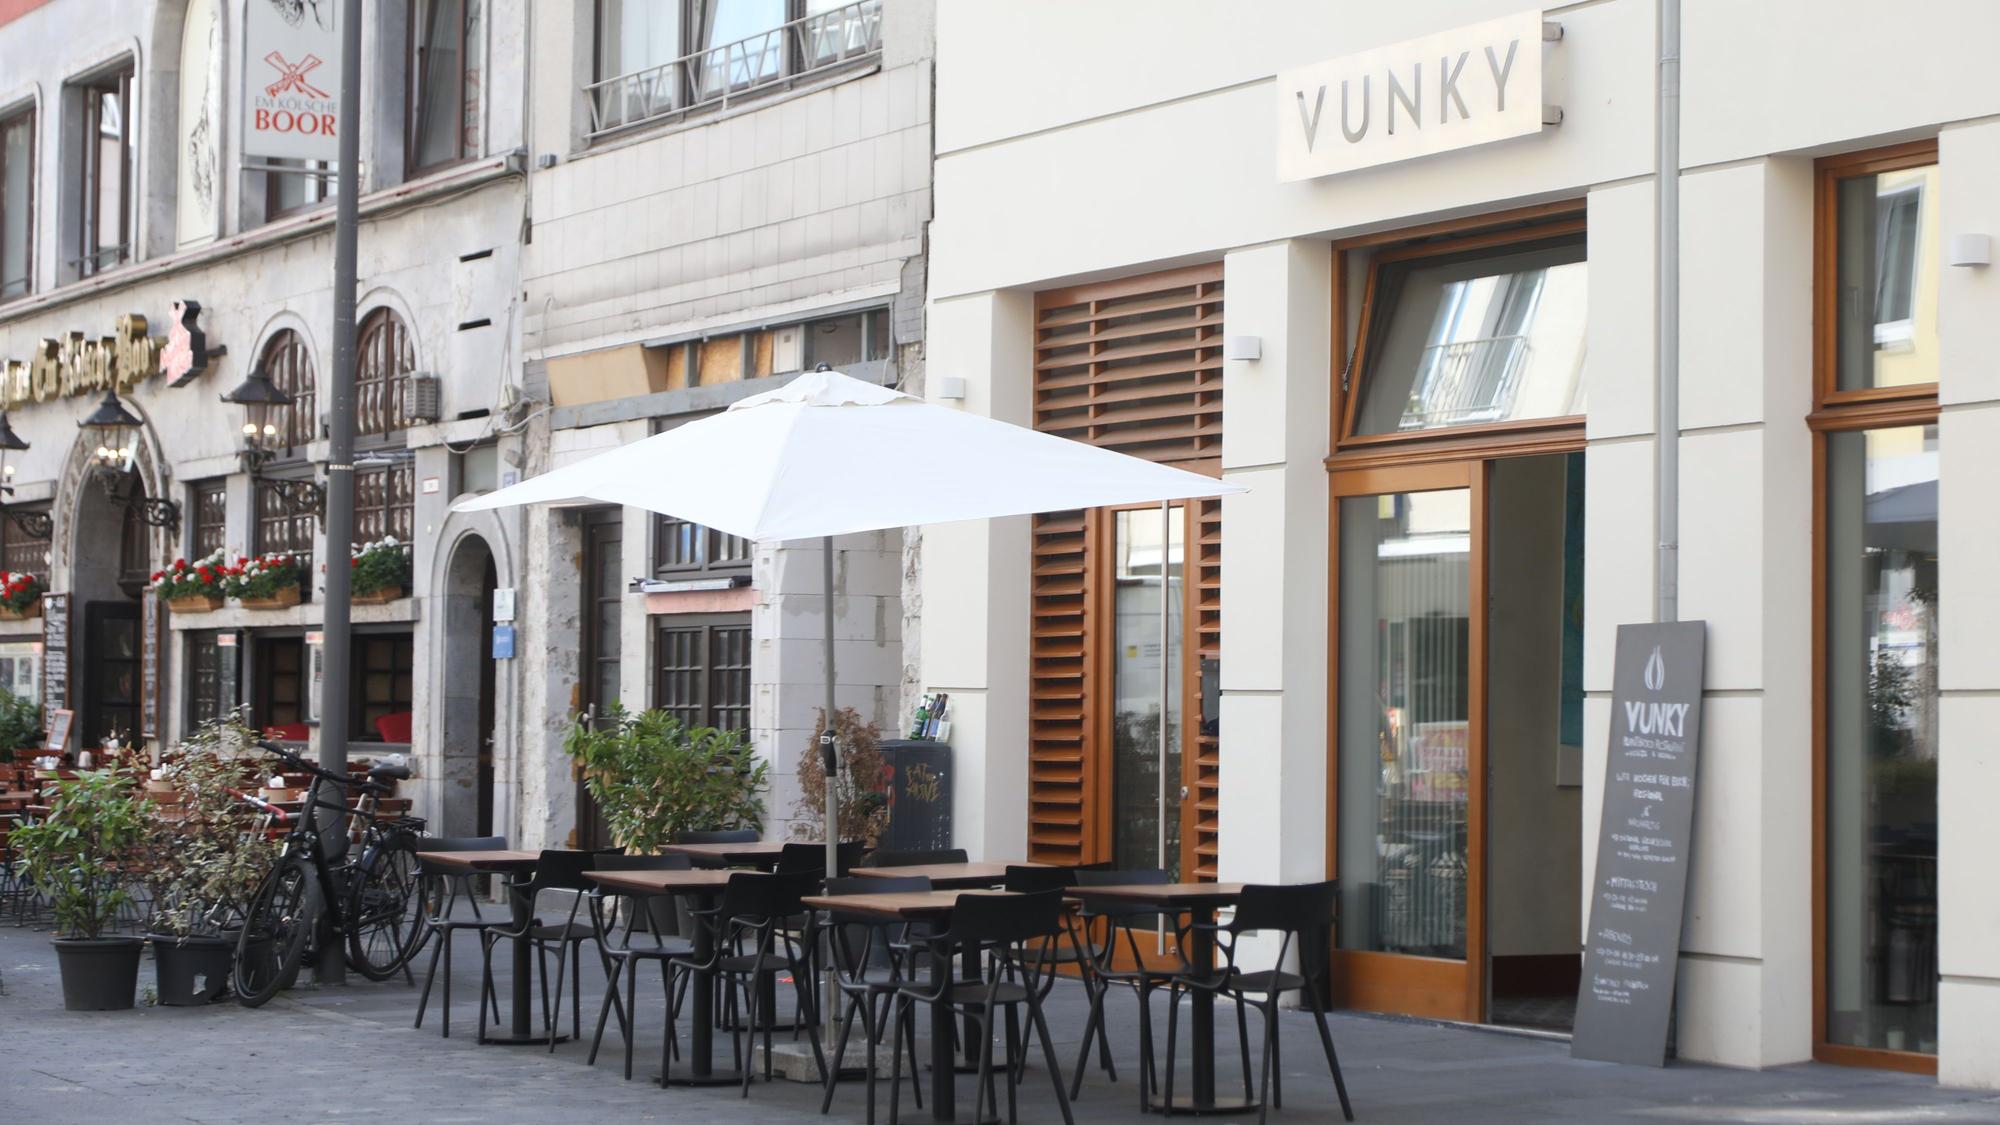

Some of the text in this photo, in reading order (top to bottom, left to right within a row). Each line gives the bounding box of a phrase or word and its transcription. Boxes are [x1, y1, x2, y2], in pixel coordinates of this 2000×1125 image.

[1296, 39, 1520, 153] VUNKY
[255, 108, 336, 136] BOOR
[1625, 701, 1690, 737] VUNKY
